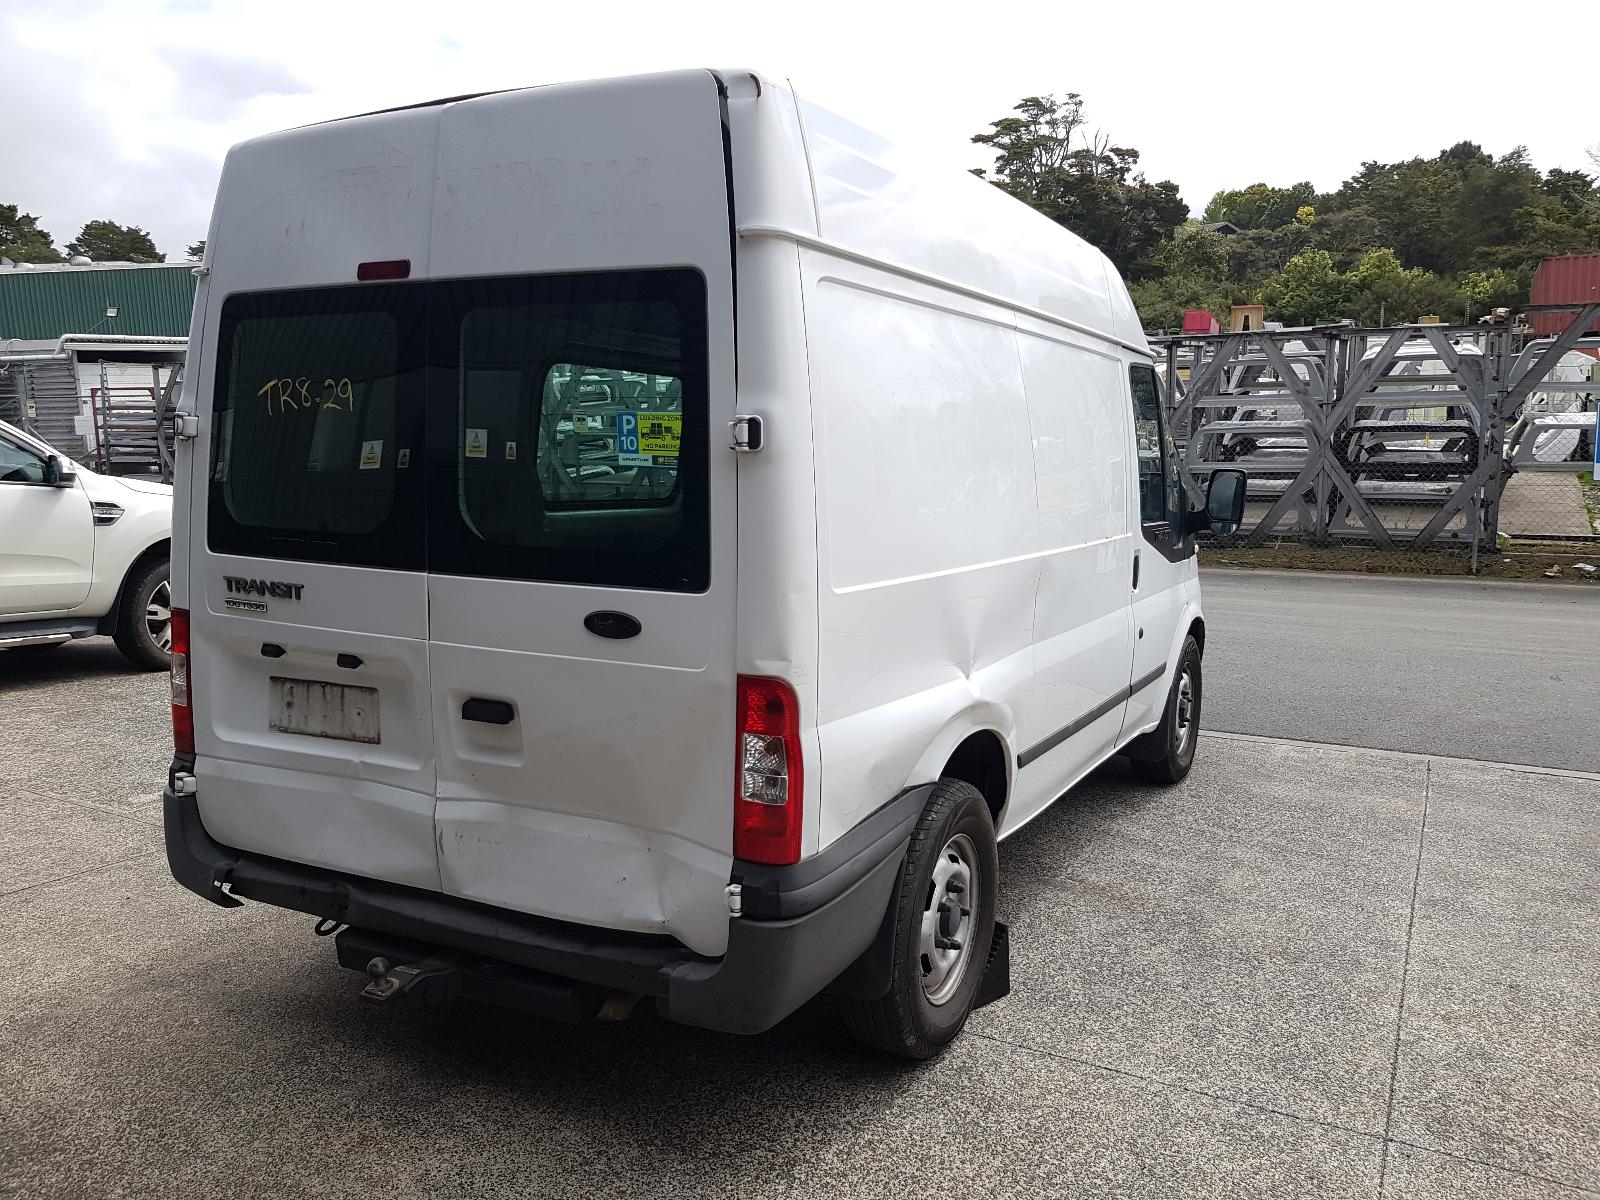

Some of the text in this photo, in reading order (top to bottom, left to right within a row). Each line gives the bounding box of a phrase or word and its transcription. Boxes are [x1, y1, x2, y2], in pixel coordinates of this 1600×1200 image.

[622, 415, 636, 435] P
[620, 436, 637, 450] 10
[222, 575, 305, 601] TRANSIT
